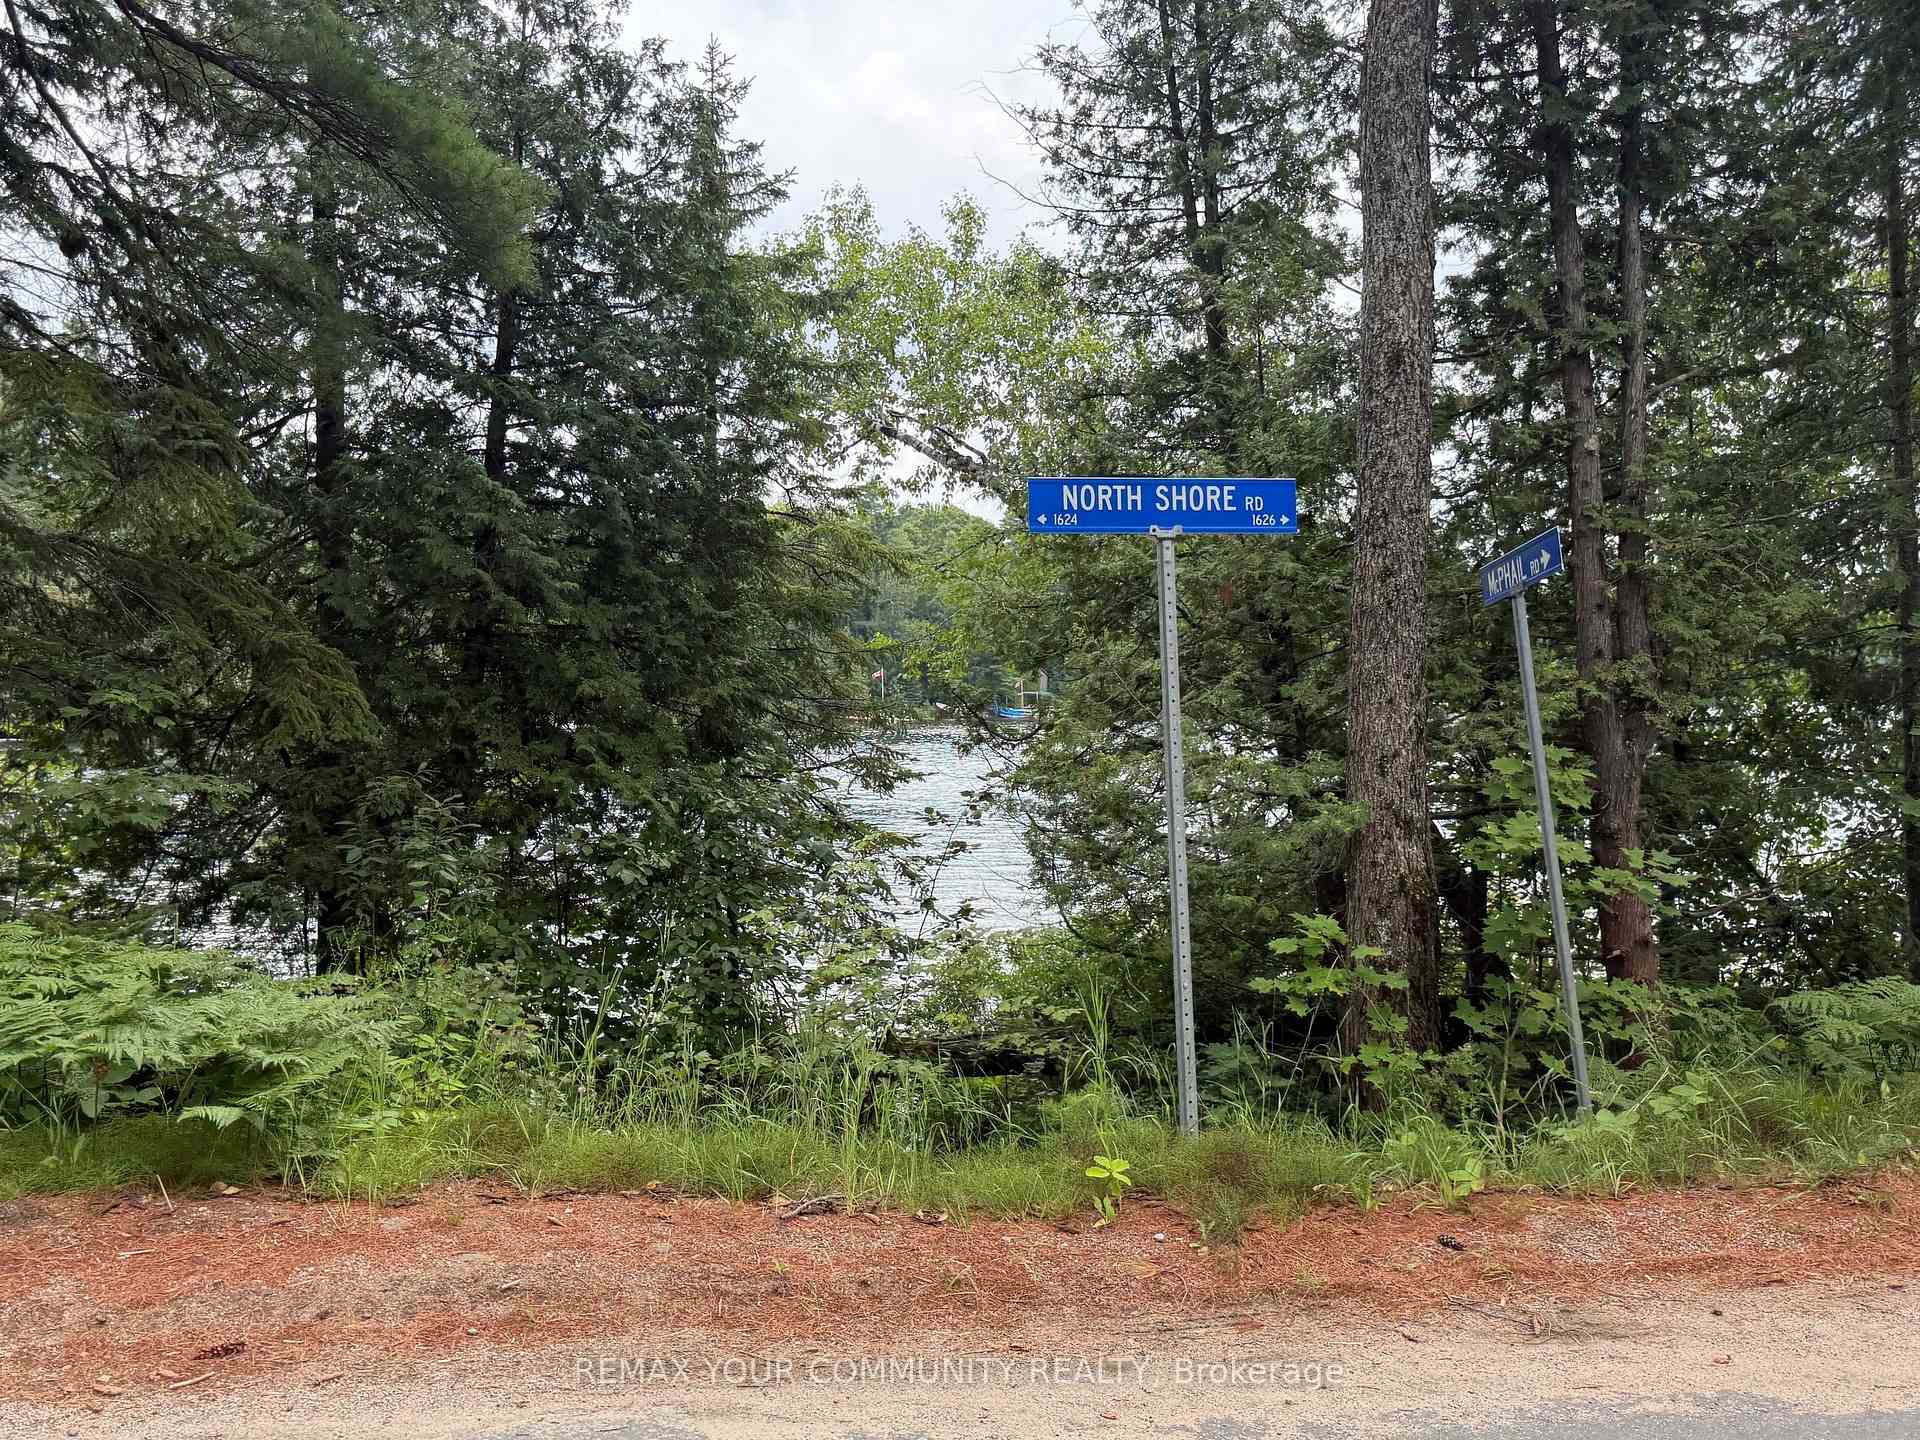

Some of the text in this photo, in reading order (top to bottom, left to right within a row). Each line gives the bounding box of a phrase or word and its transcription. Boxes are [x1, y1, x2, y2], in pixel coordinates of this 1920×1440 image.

[1063, 485, 1264, 511] NORTH SHORE RD
[1053, 513, 1078, 526] 1624
[1252, 513, 1276, 526] 1626
[1529, 559, 1540, 576] RD
